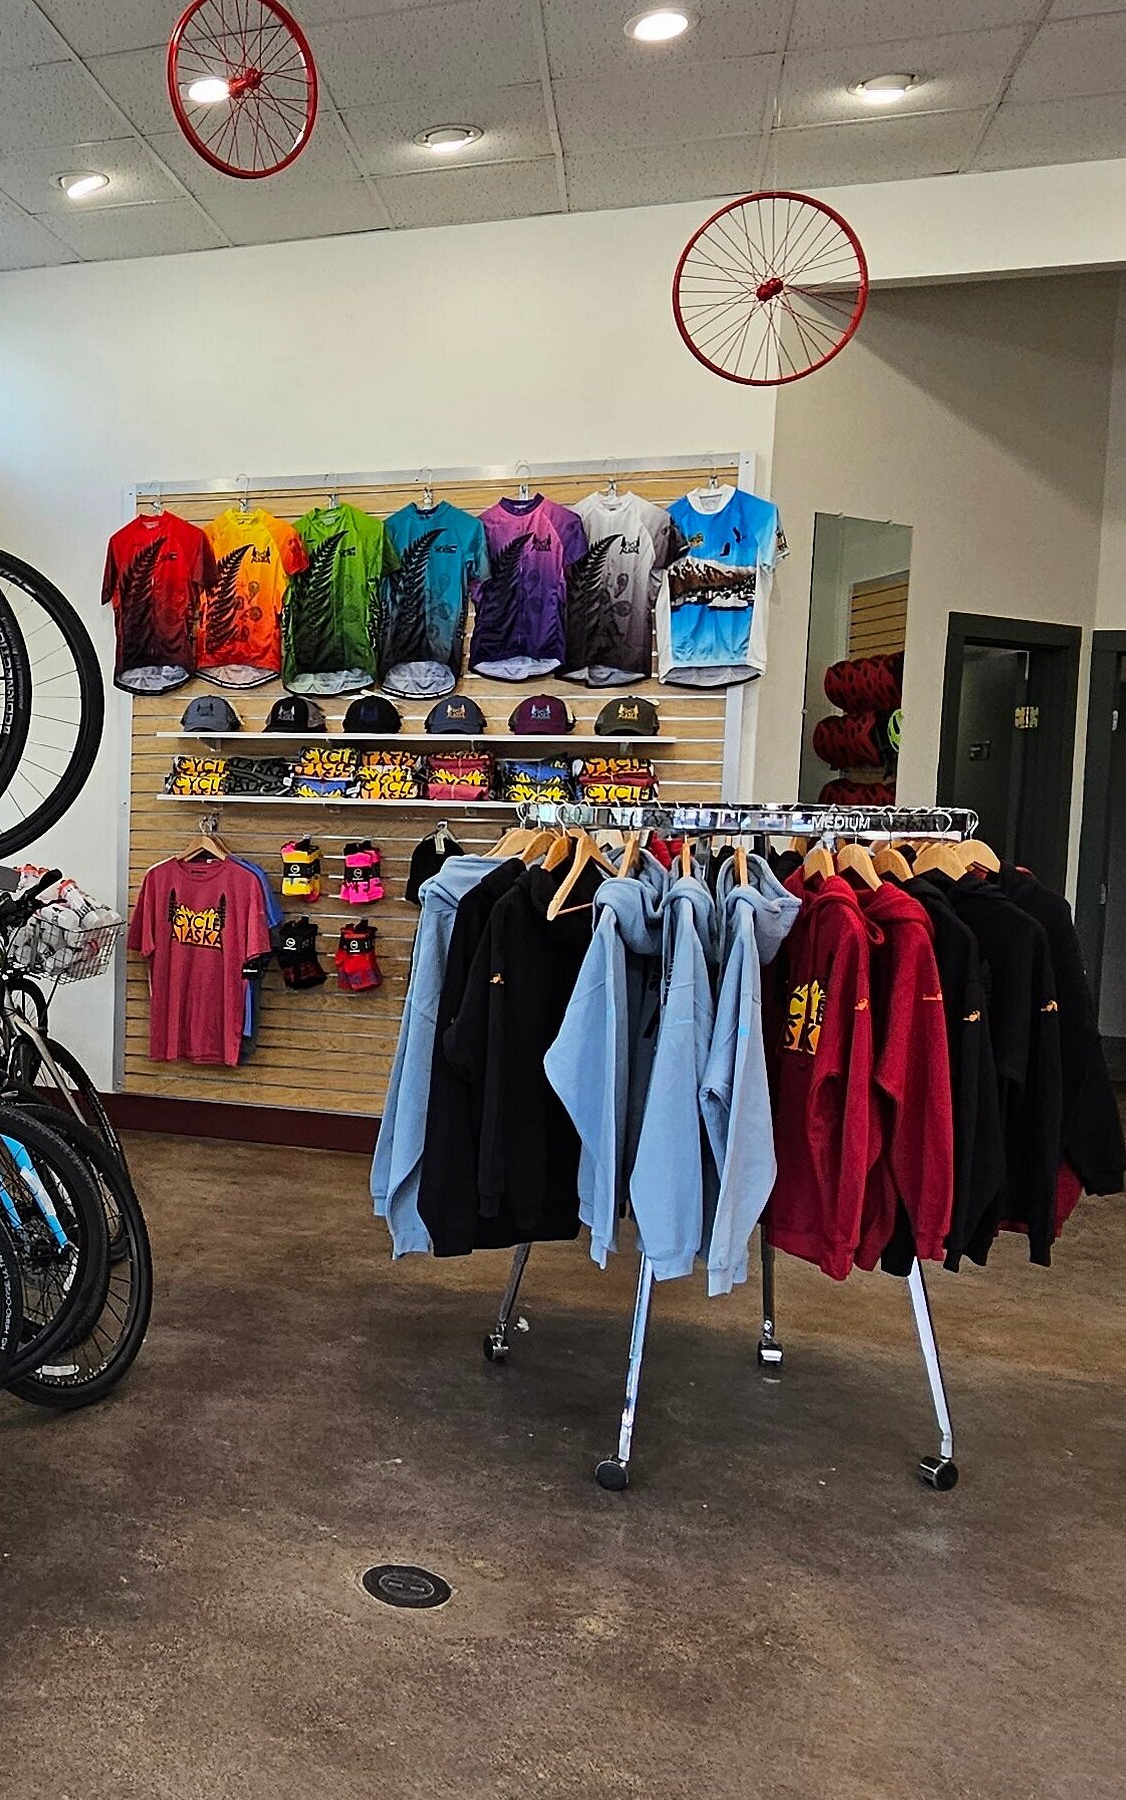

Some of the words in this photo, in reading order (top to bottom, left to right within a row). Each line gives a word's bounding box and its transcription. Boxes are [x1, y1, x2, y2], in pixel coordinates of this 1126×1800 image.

[586, 786, 649, 800] CYCLE
[812, 815, 871, 829] MEDIUM
[174, 914, 221, 932] CYCLE
[171, 927, 222, 946] ALASKA
